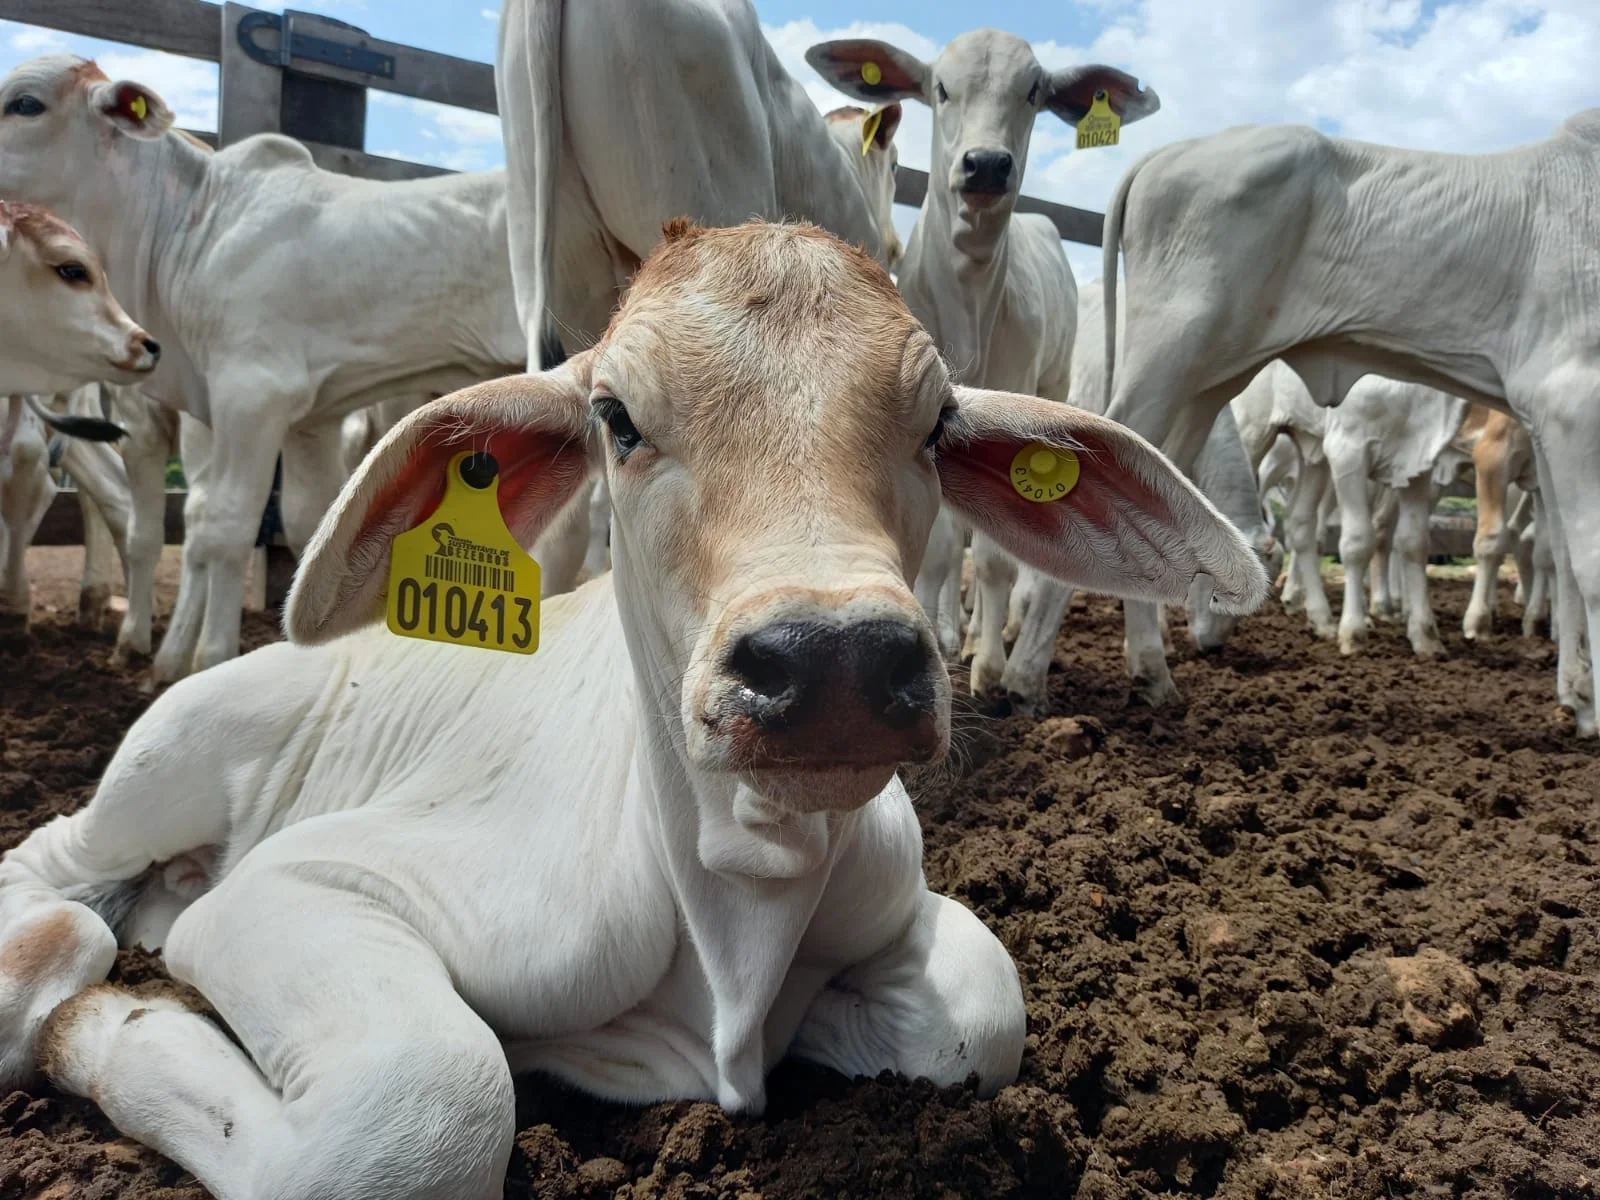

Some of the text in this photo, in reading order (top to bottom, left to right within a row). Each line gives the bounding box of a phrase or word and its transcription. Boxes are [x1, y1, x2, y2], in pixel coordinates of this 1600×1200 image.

[1079, 129, 1117, 148] 010421
[1015, 467, 1066, 499] 010413
[397, 577, 532, 648] 010413
